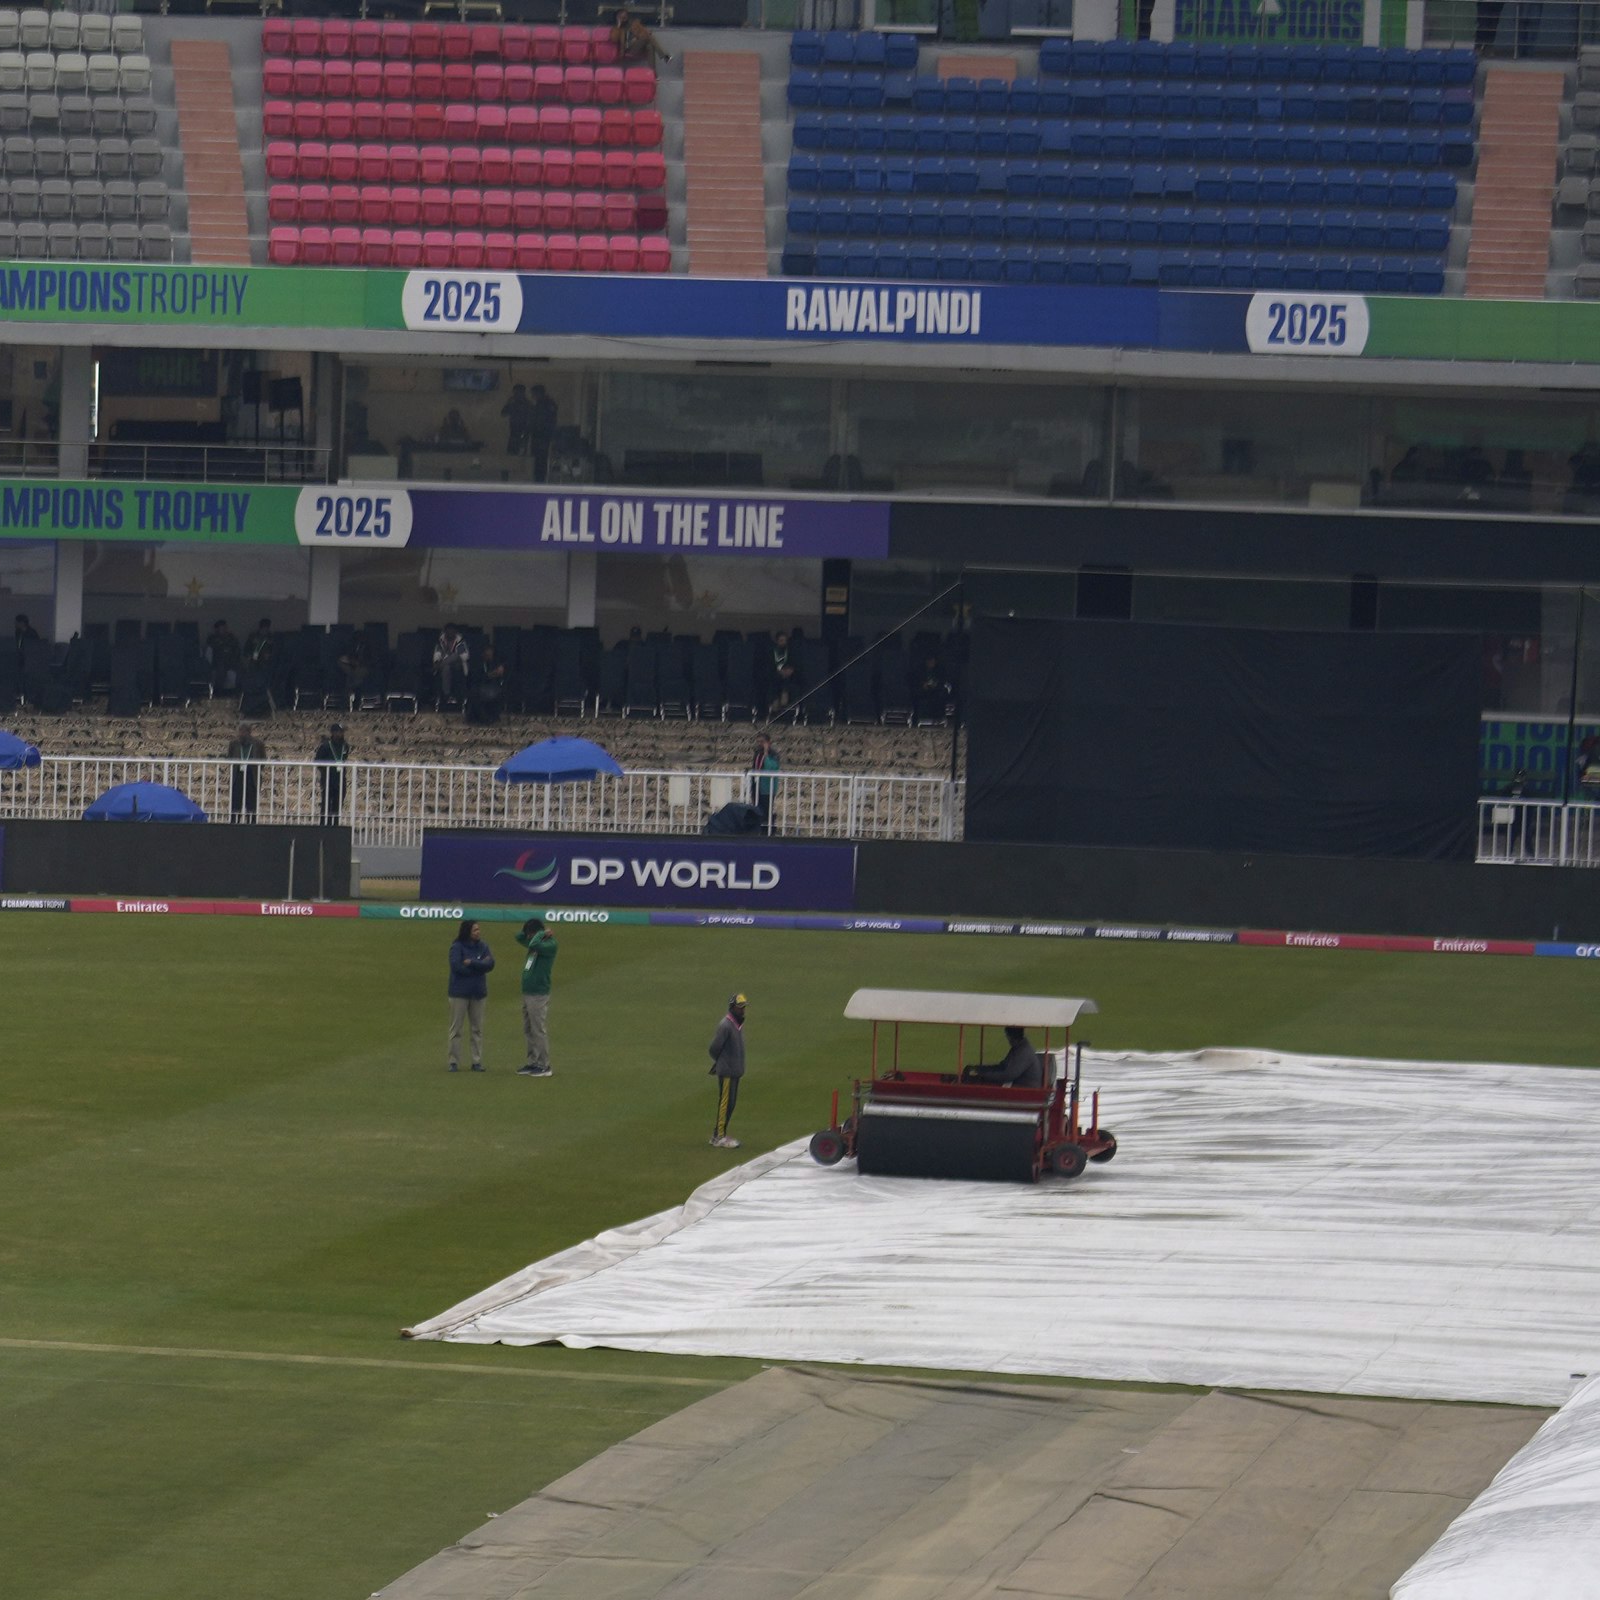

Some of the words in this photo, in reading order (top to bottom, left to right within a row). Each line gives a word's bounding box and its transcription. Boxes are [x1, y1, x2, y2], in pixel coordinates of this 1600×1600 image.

[423, 280, 501, 323] 2025
[786, 288, 981, 335] RAWALPINDI
[1267, 303, 1347, 346] 2025
[136, 490, 250, 532] TROPHY
[315, 496, 391, 538] 2025
[540, 499, 596, 543] ALL
[600, 501, 644, 544] ON
[653, 503, 709, 547] THE
[717, 504, 785, 549] LINE
[570, 858, 624, 886] DP
[632, 859, 781, 890] WORLD
[117, 901, 168, 913] Emirates
[261, 903, 313, 915] Emirates
[400, 907, 463, 919] aramco
[545, 910, 608, 922] aramco
[709, 916, 720, 924] DP
[722, 916, 754, 925] WORLD
[868, 921, 900, 929] WORLD
[1286, 933, 1339, 947] Emirates
[1434, 939, 1487, 953] Emirates
